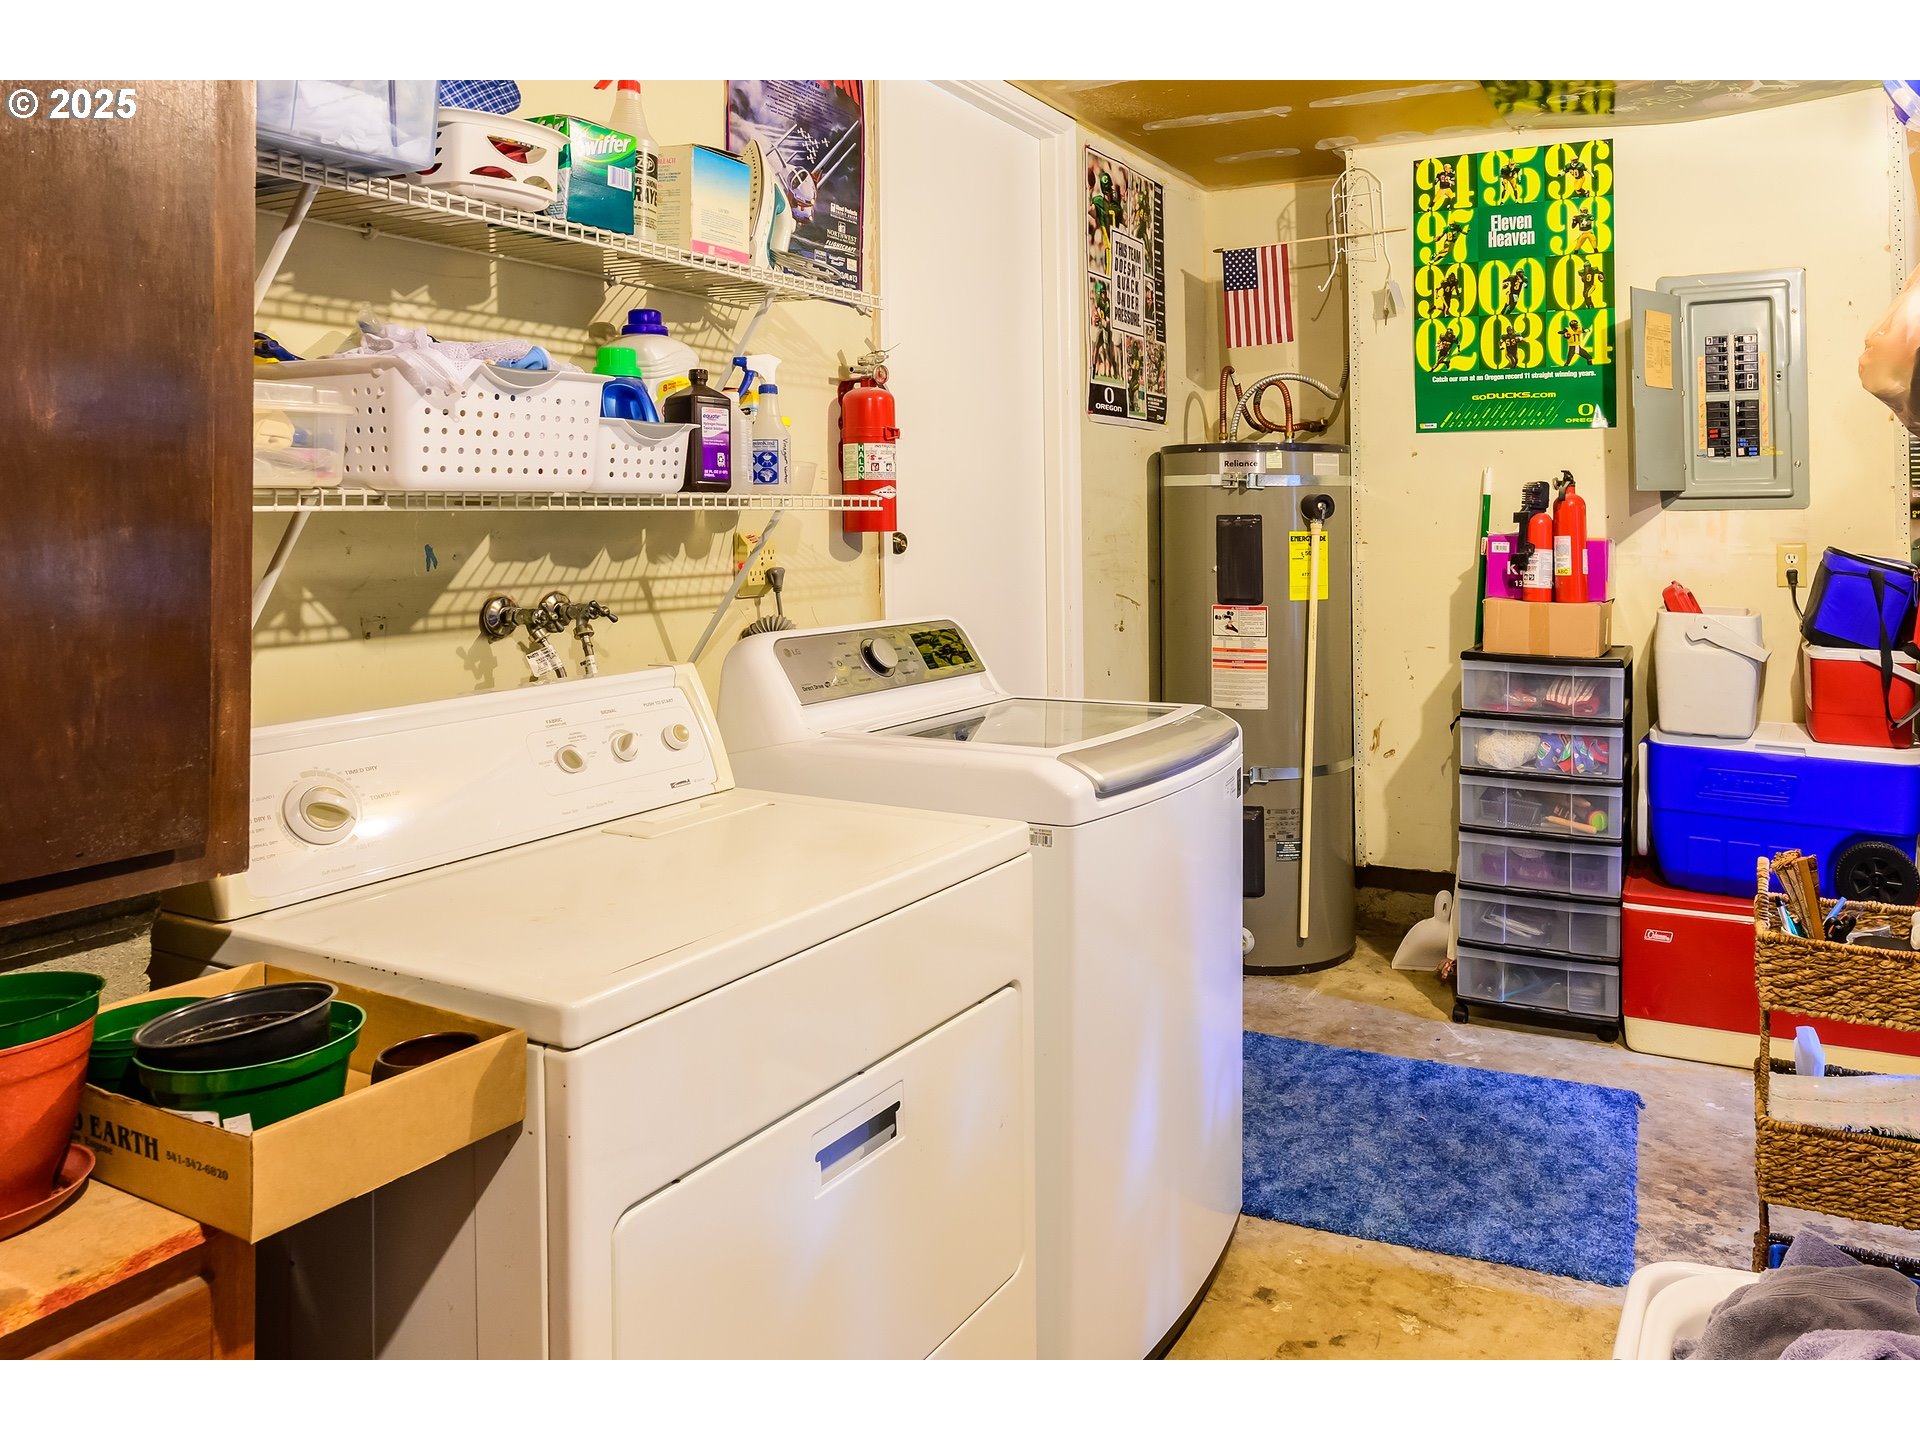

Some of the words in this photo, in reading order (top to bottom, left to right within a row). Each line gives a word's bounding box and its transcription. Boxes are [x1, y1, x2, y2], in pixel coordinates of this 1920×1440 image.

[583, 133, 631, 157] wiffer
[1416, 154, 1475, 212] 94
[1480, 146, 1541, 206] 95
[1544, 140, 1613, 200] 96
[1416, 209, 1474, 266] 97
[1546, 196, 1612, 256] 98
[1490, 214, 1533, 231] Eleven
[1115, 240, 1127, 258] THIS
[1488, 230, 1536, 248] Heaven
[1114, 257, 1142, 280] DOESN'T
[1116, 274, 1139, 295] QUACK
[1415, 262, 1478, 319] 99
[1478, 257, 1545, 315] 00
[1552, 253, 1607, 311] 01
[1116, 290, 1139, 311] UNDER
[1415, 316, 1477, 372] 02
[1480, 312, 1544, 370] 03
[1547, 308, 1613, 367] 04
[1531, 371, 1554, 380] straight
[1554, 370, 1577, 378] winning
[1578, 370, 1597, 378] years.
[1095, 402, 1123, 413] OREGON
[344, 767, 364, 776] TIMED
[370, 791, 392, 800] TOUCH
[253, 815, 266, 823] DRY
[89, 1113, 160, 1162] EARTH
[166, 1150, 229, 1181] 541-342-6820
